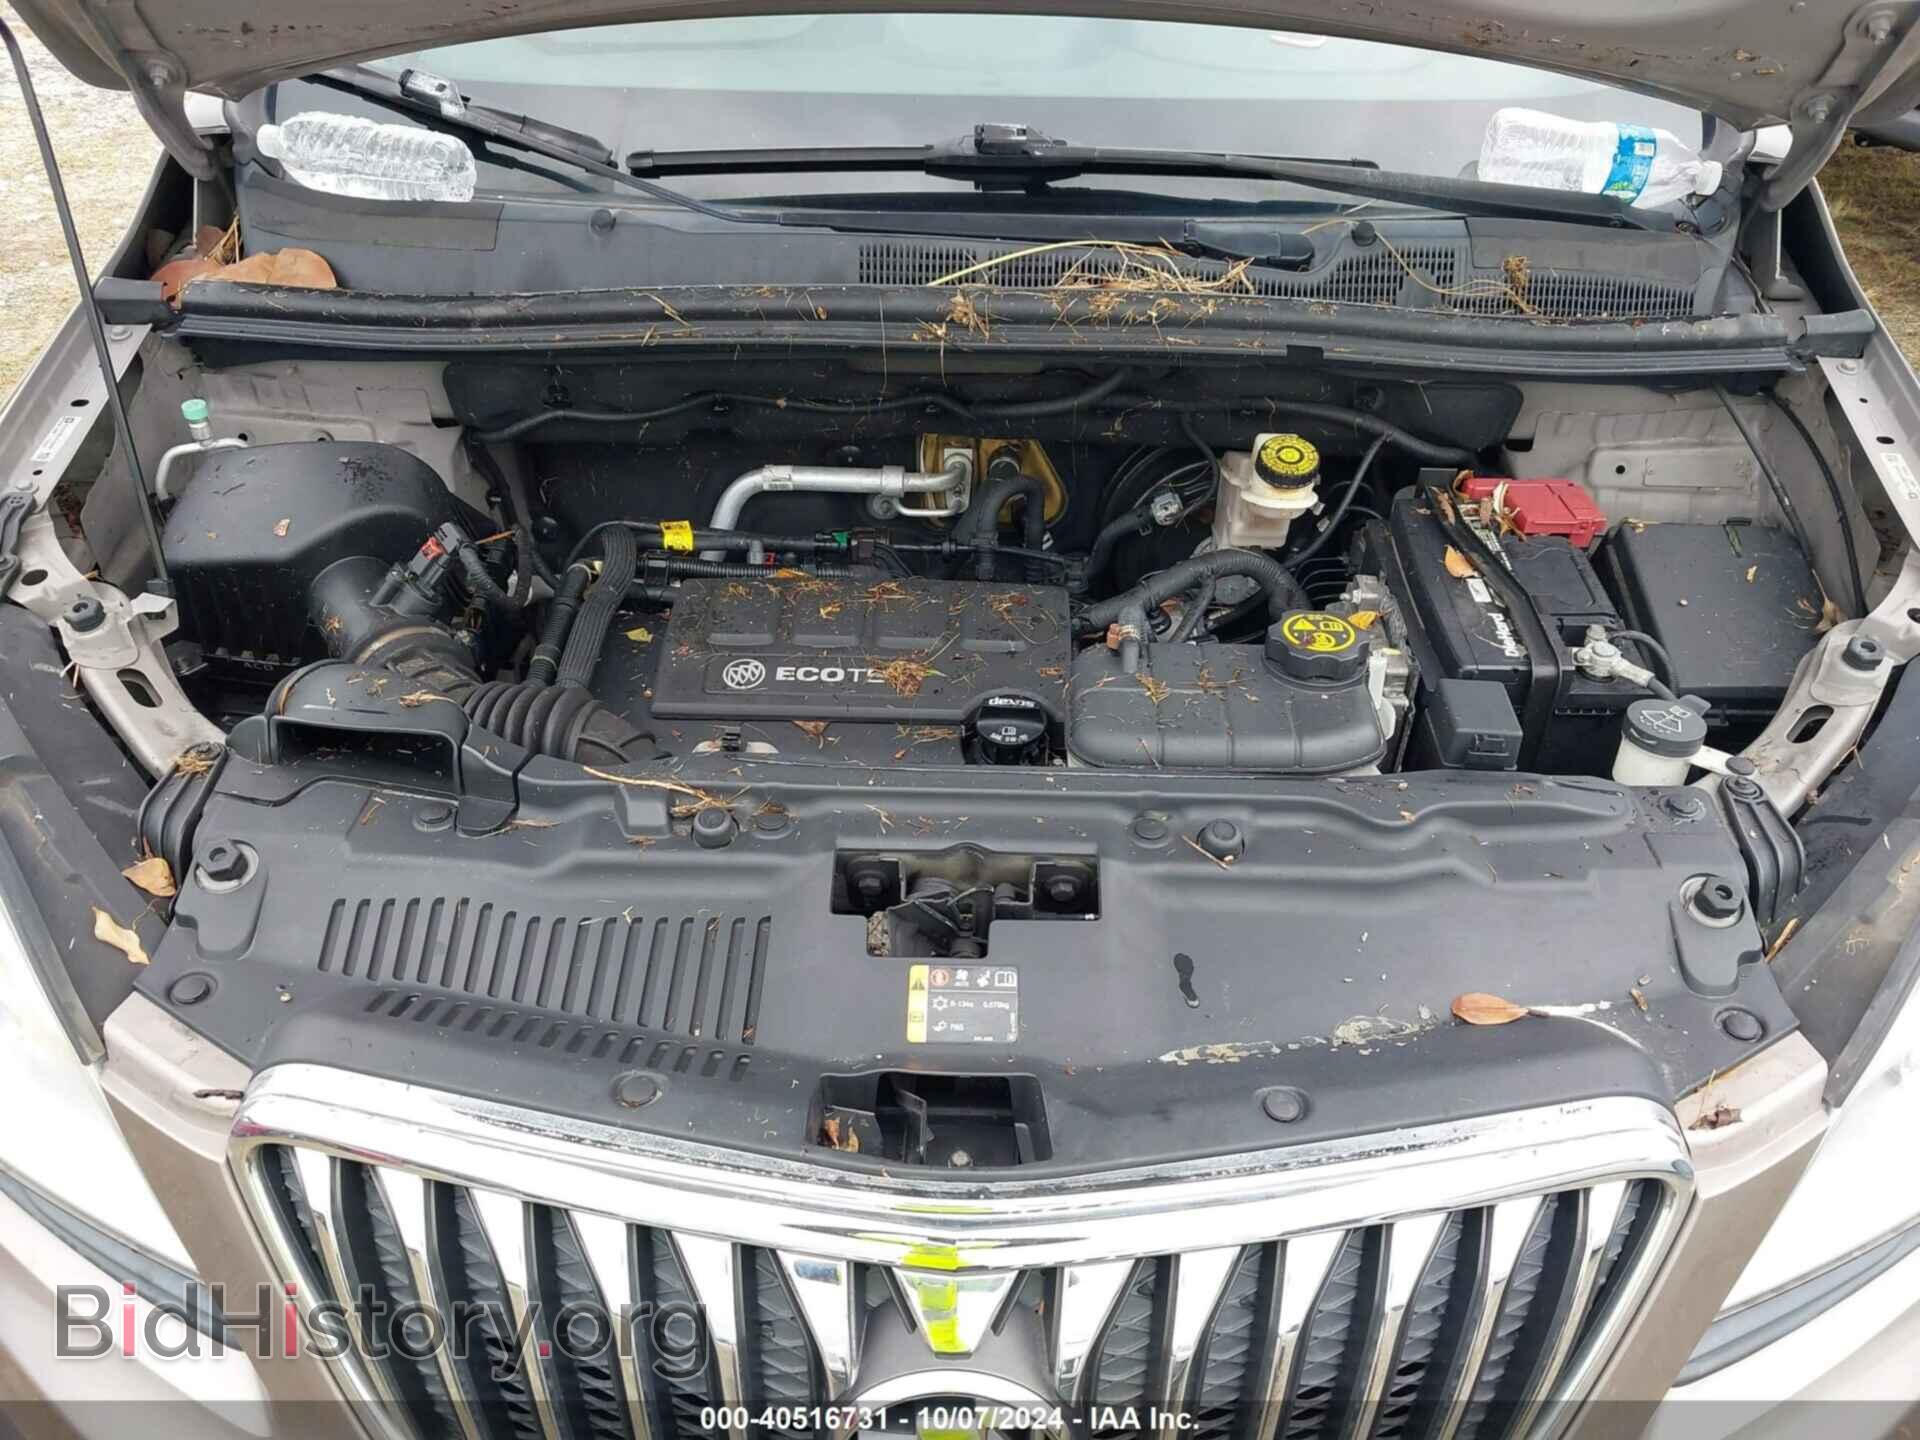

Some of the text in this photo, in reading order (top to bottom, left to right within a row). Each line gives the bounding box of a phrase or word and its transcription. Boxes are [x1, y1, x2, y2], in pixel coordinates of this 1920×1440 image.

[1487, 612, 1519, 657] DieHard
[775, 666, 888, 684] ECOTE
[988, 696, 1036, 708] dexos
